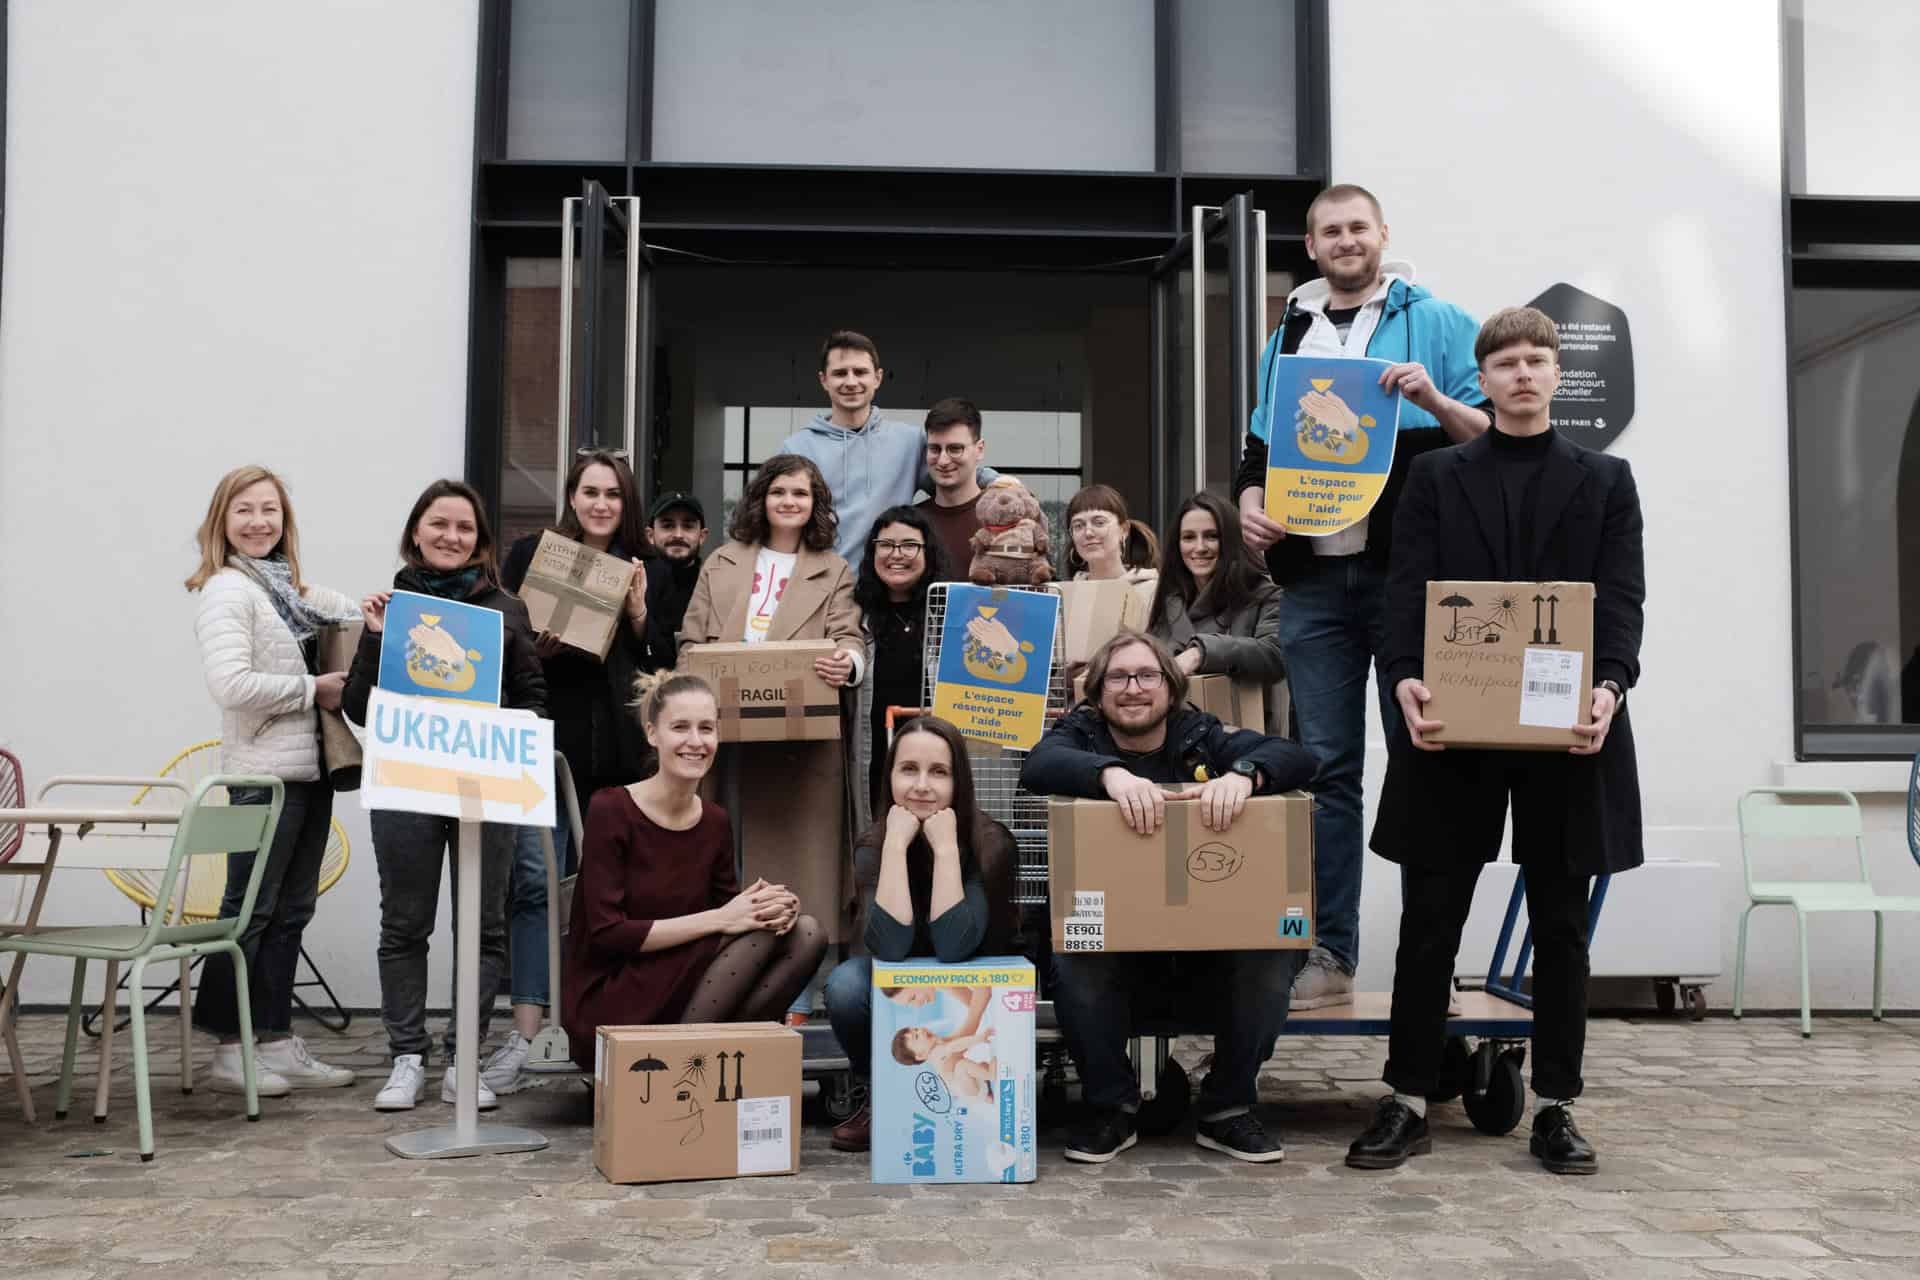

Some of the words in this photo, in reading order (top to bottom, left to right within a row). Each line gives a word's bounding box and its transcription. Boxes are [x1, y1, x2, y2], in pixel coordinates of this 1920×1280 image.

[1559, 333, 1584, 341] néreux
[1558, 369, 1597, 379] ondation
[1559, 379, 1607, 388] ettencourt
[1571, 418, 1592, 427] PARIS
[1300, 475, 1356, 488] L'espace
[1287, 487, 1334, 500] réservé
[1338, 493, 1364, 503] pour
[1308, 502, 1342, 513] l'aide
[735, 687, 790, 702] RAGIL
[964, 690, 1015, 705] L'espace
[952, 702, 995, 715] réservé
[998, 708, 1024, 718] pour
[970, 715, 1002, 727] l'aide
[374, 703, 538, 766] UKRAINE
[958, 727, 1019, 742] umanitaire
[1191, 850, 1236, 872] 531
[1065, 925, 1103, 936] T0633
[1283, 919, 1302, 936] M
[1065, 940, 1103, 950] S5388
[893, 974, 949, 984] ECONOMY
[951, 974, 979, 984] PACK
[990, 974, 1009, 983] 180
[1003, 993, 1022, 1012] 4
[953, 1120, 964, 1142] DRY
[912, 1112, 937, 1177] BABY
[953, 1143, 964, 1176] ULTRA
